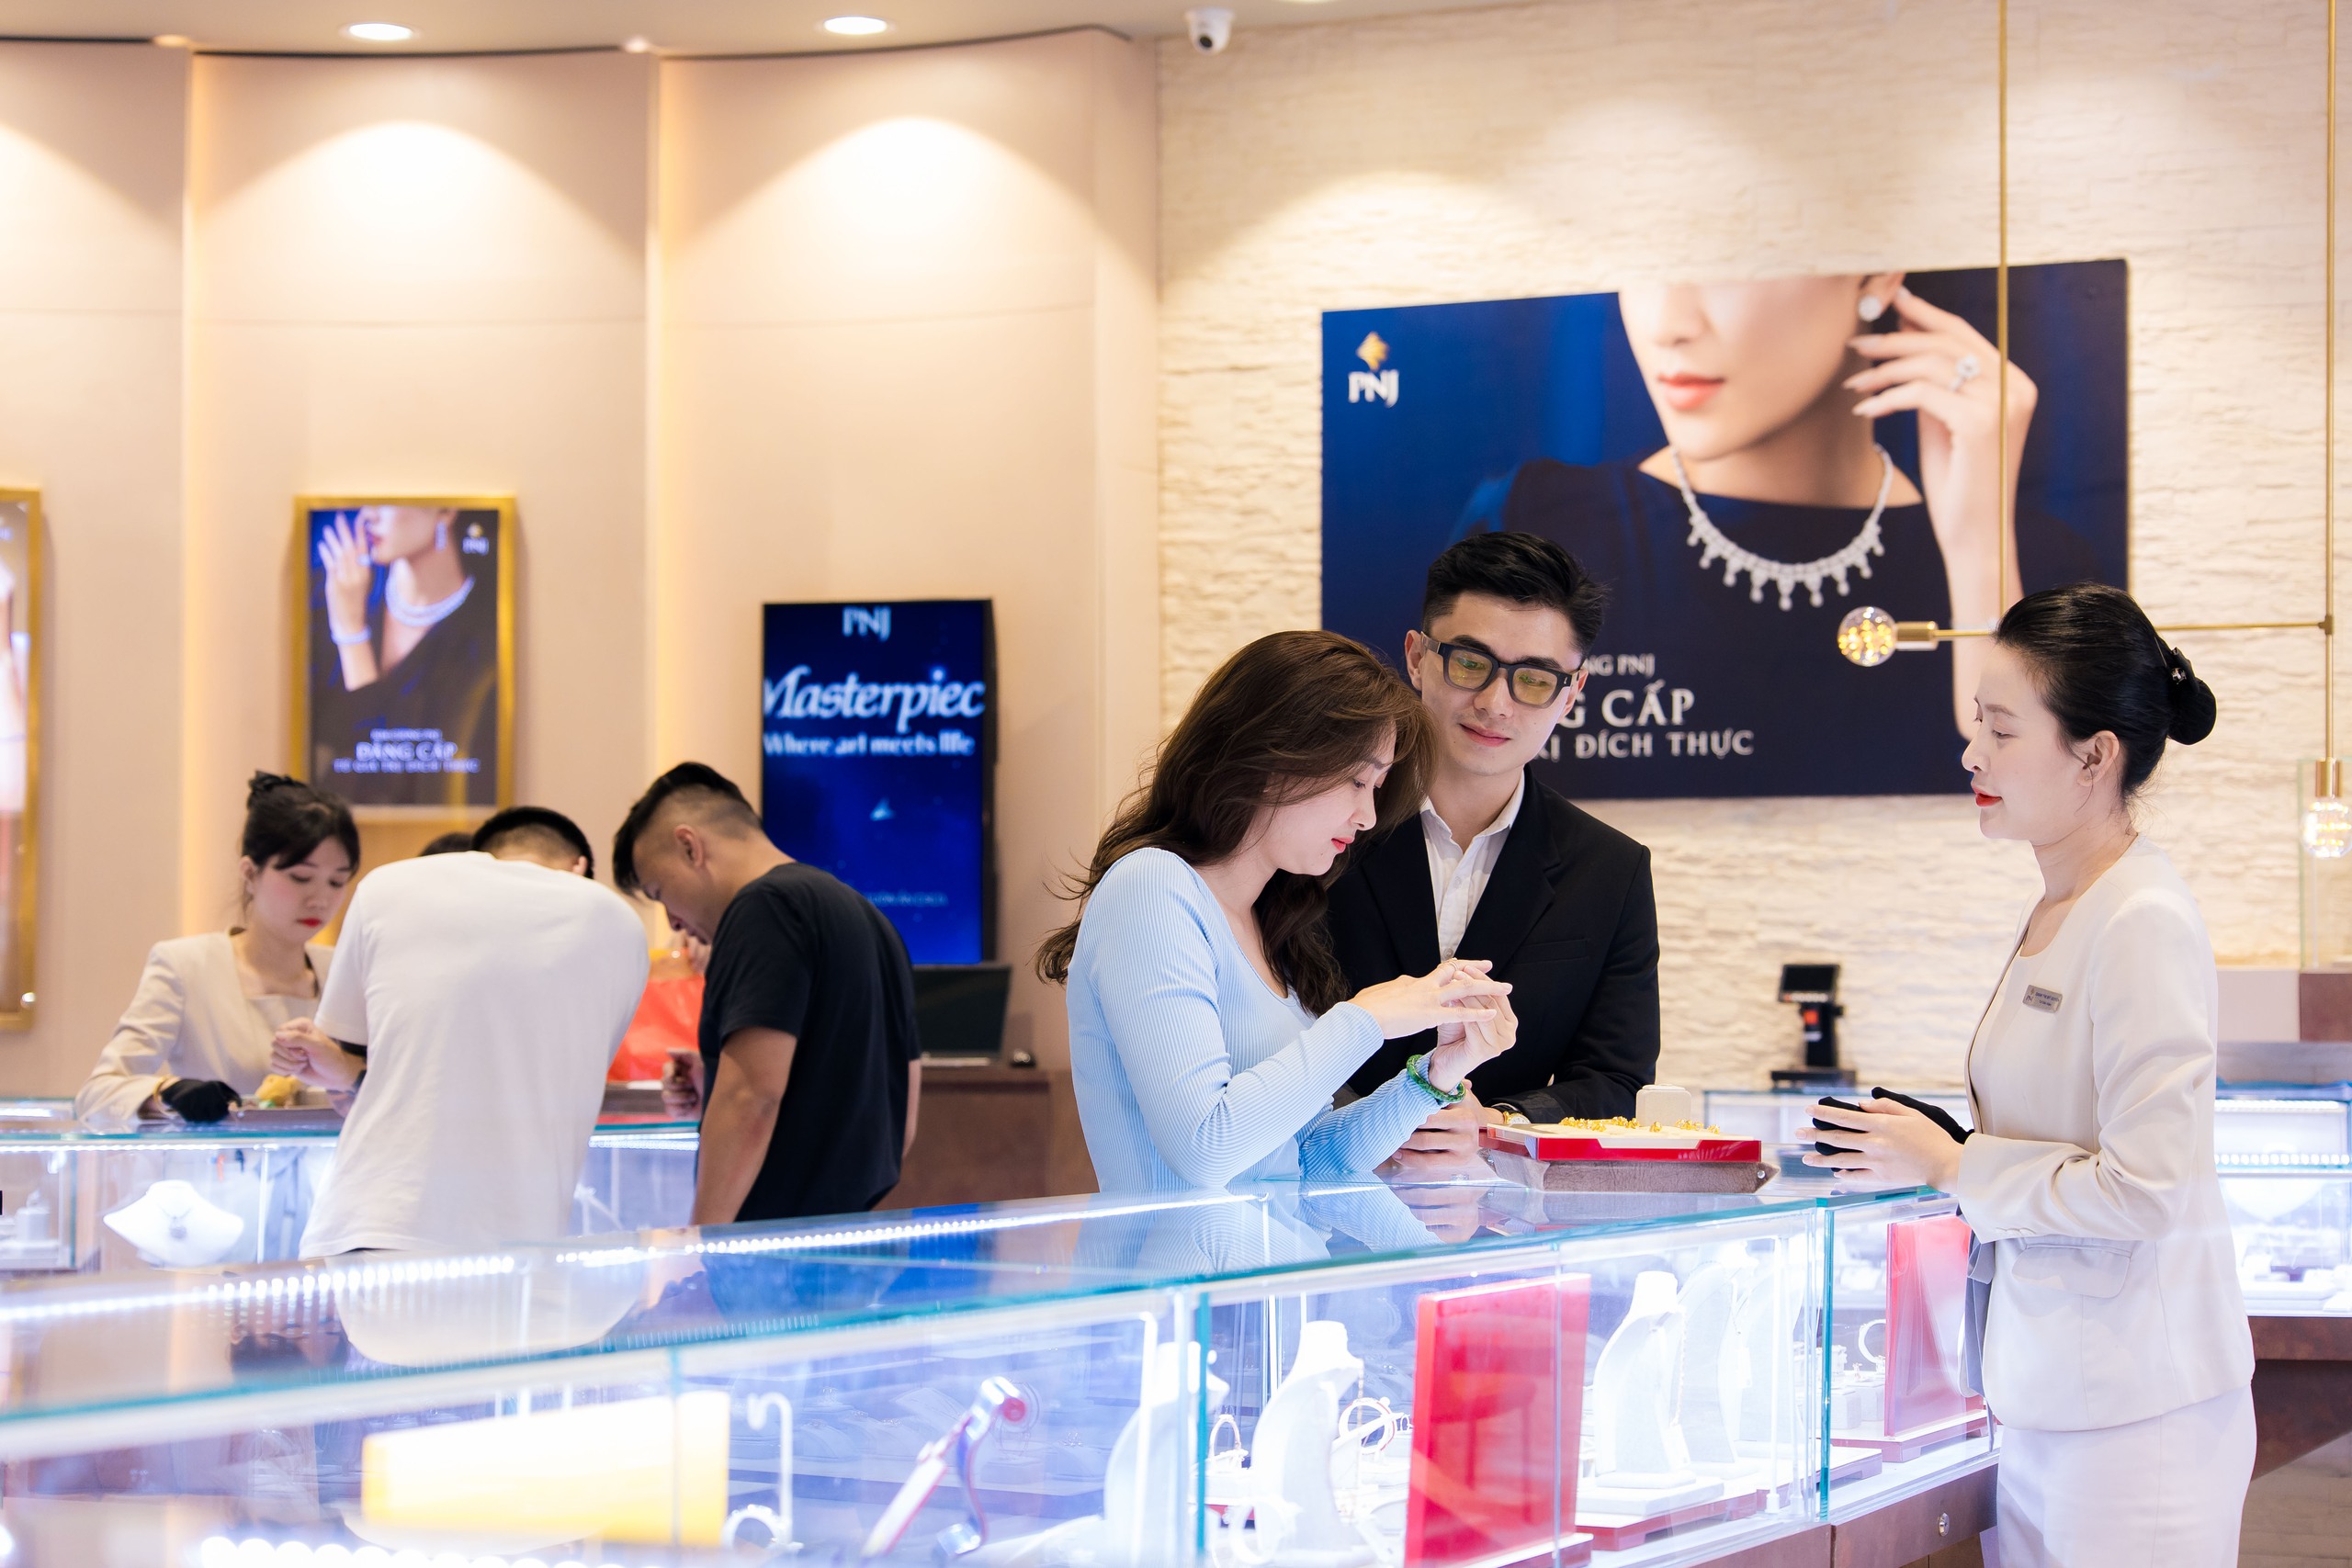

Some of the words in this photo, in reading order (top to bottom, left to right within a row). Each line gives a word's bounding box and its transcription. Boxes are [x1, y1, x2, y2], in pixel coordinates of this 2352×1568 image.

[1348, 368, 1399, 409] PNJ
[842, 605, 891, 641] PNJ
[1600, 679, 1695, 728] CẤP
